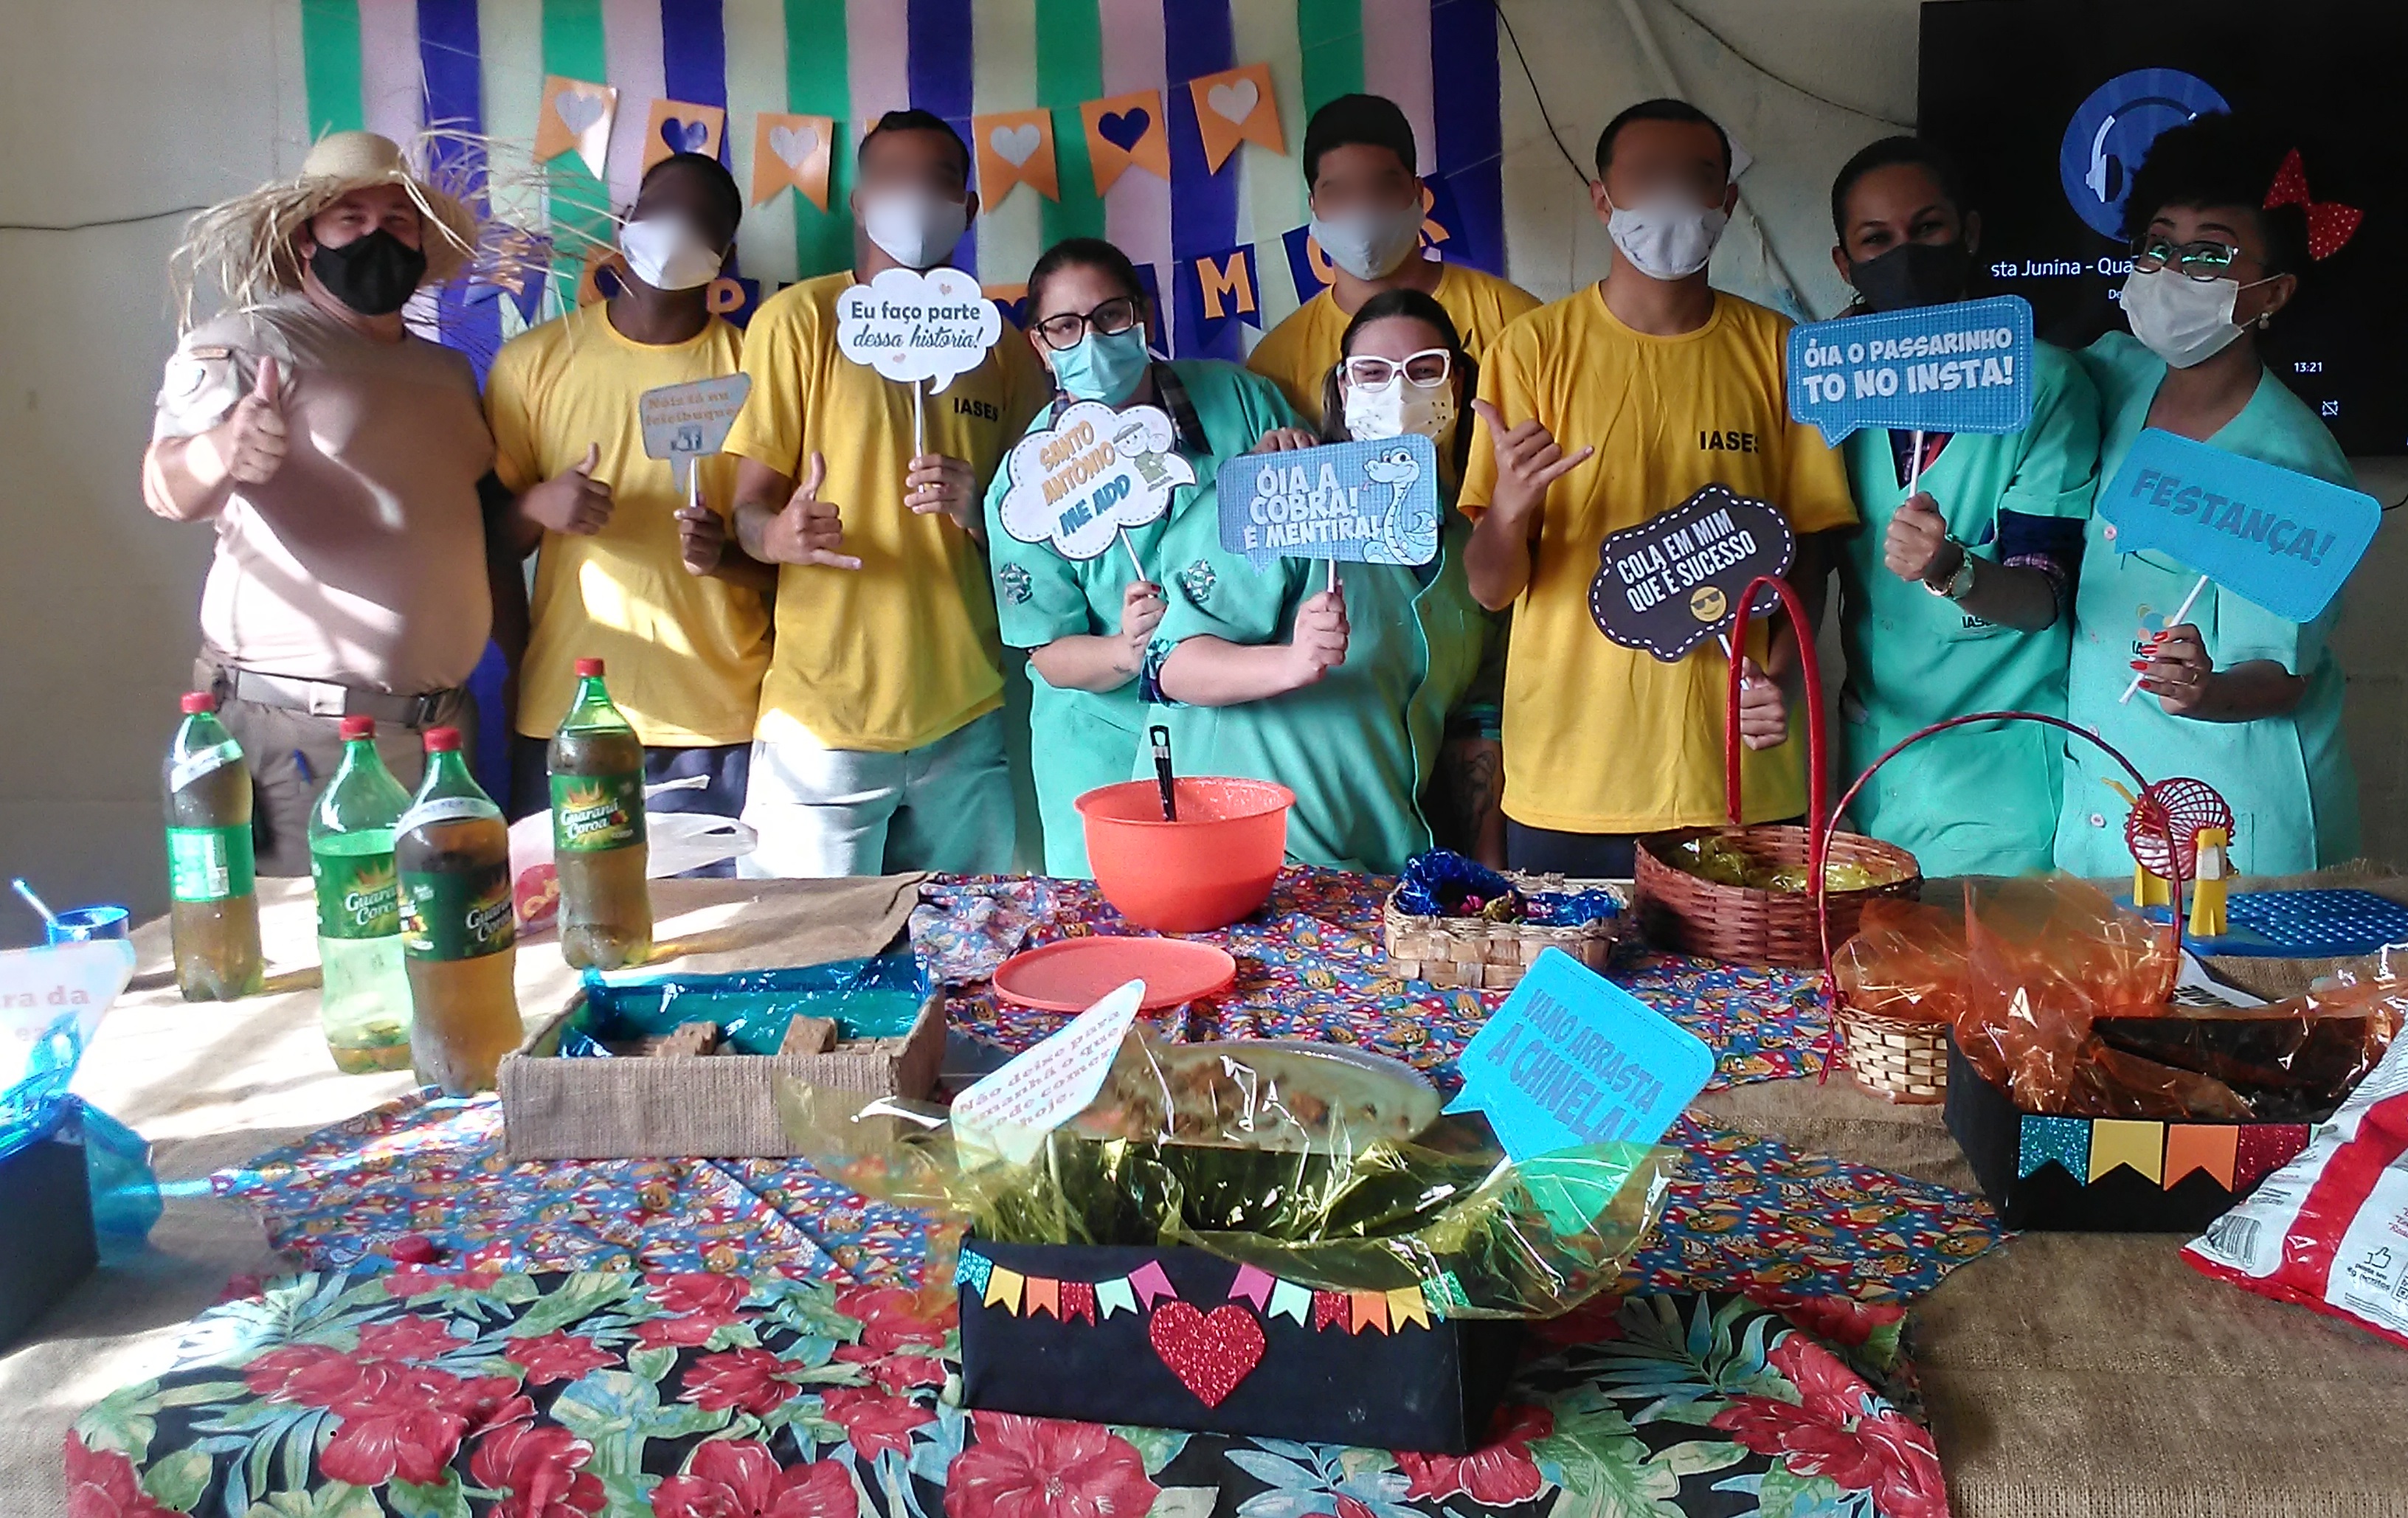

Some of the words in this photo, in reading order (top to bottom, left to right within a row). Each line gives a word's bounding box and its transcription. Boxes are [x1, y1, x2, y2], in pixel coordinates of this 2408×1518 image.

[1990, 260, 2018, 277] sta
[2021, 258, 2081, 277] Junina
[2097, 257, 2134, 277] Qua
[851, 300, 876, 319] Eu
[882, 300, 922, 325] faço
[928, 302, 980, 324] parte
[853, 323, 904, 348] dessa
[1804, 338, 1844, 369] ÓIA
[1847, 343, 1865, 364] O
[1869, 327, 2013, 362] PASSARINHO
[1803, 372, 1847, 405] TO
[1854, 367, 1900, 401] NO
[1907, 356, 2015, 395] INSTA!
[2294, 361, 2323, 372] 13:21
[1039, 420, 1095, 473] SANTO
[1256, 462, 1310, 498] ÓIA
[1318, 462, 1340, 492] A
[1059, 499, 1093, 538] ME
[1092, 474, 1131, 516] ADD
[1250, 487, 1359, 526] COBRA!
[2130, 468, 2337, 569] FESTANÇA!
[1265, 515, 1382, 549] MENTIRA!
[1616, 543, 1667, 585] COLA
[1661, 527, 1695, 562] EM
[1690, 507, 1736, 547] MIM
[1625, 575, 1667, 614] QUE
[1675, 530, 1757, 587] SUCESSO
[567, 817, 611, 840] Coroa
[47, 985, 91, 1005] da
[1070, 1011, 1121, 1051] para
[1079, 1027, 1119, 1058] que
[1522, 987, 1580, 1044] VAMO
[1565, 1026, 1665, 1116] ARRASTA
[1040, 1047, 1111, 1098] comer
[1485, 1022, 1524, 1067] A
[1509, 1039, 1641, 1146] CHINELA!
